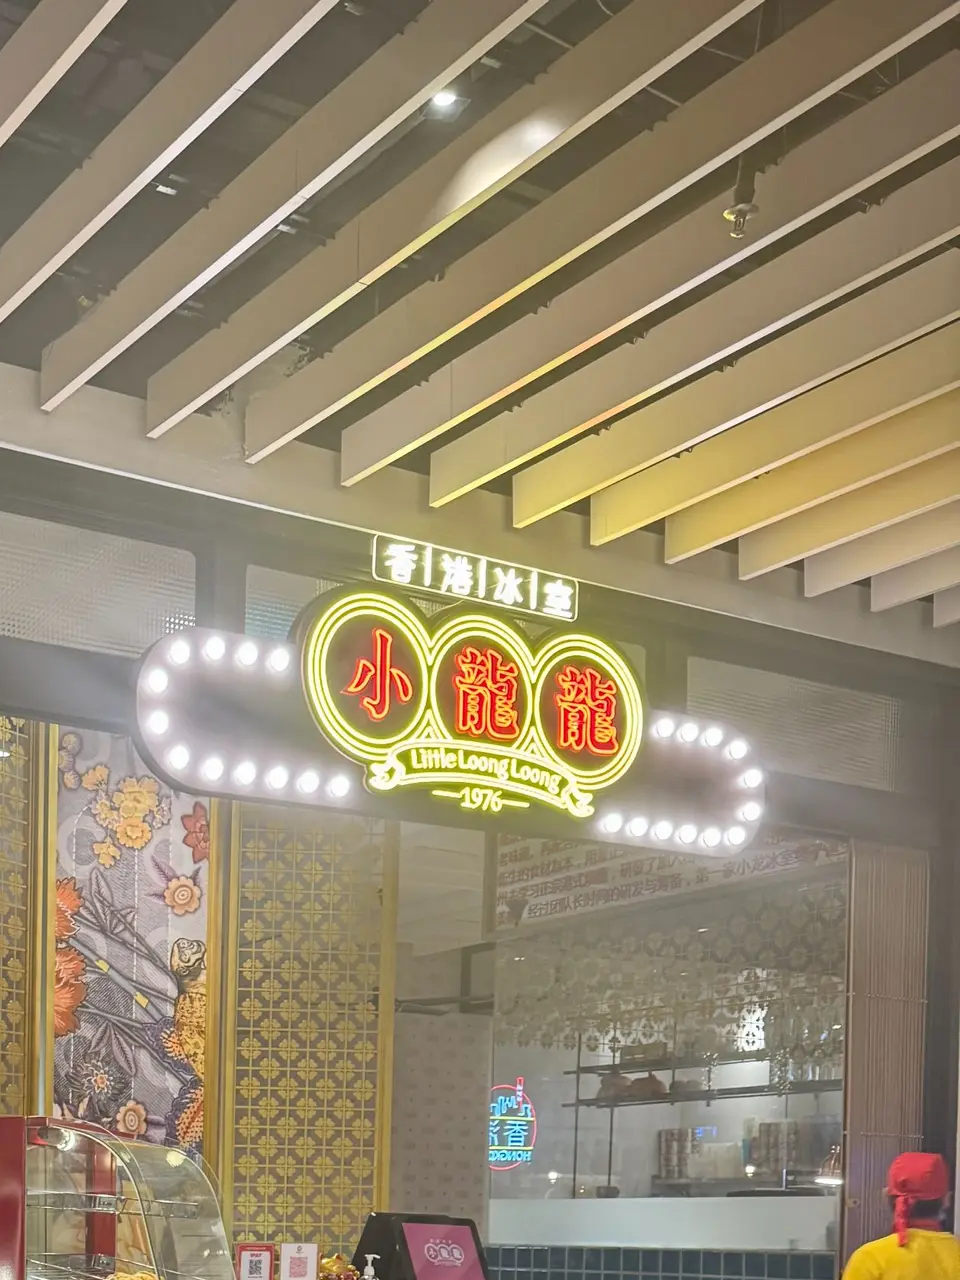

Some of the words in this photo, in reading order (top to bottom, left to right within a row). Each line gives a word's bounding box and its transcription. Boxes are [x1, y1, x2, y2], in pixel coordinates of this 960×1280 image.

[384, 544, 574, 619] 香港冰室
[341, 628, 619, 755] 小龍龍
[410, 748, 458, 769] Little
[458, 750, 510, 780] Loong
[511, 760, 562, 795] Loong
[460, 787, 503, 812] 1976
